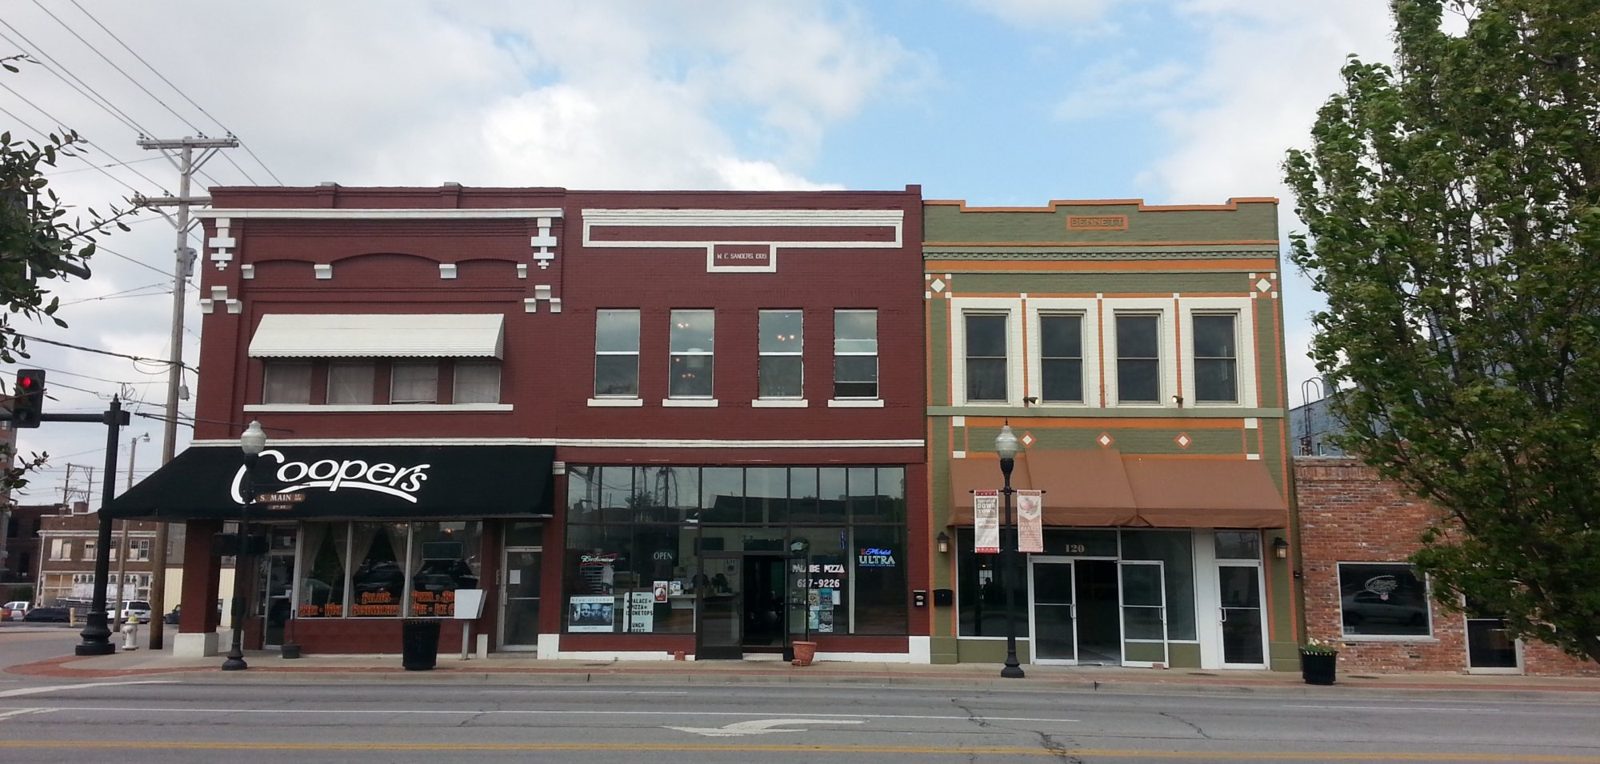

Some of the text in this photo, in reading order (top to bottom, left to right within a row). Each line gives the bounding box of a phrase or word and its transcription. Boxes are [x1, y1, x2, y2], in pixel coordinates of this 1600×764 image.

[1071, 218, 1122, 226] BENNETT
[270, 493, 291, 502] MAIN
[1065, 544, 1085, 553] 120
[653, 552, 673, 561] OPEN
[859, 555, 896, 564] ULTRA
[824, 564, 845, 573] PIZZA
[797, 579, 840, 588] 627-9226
